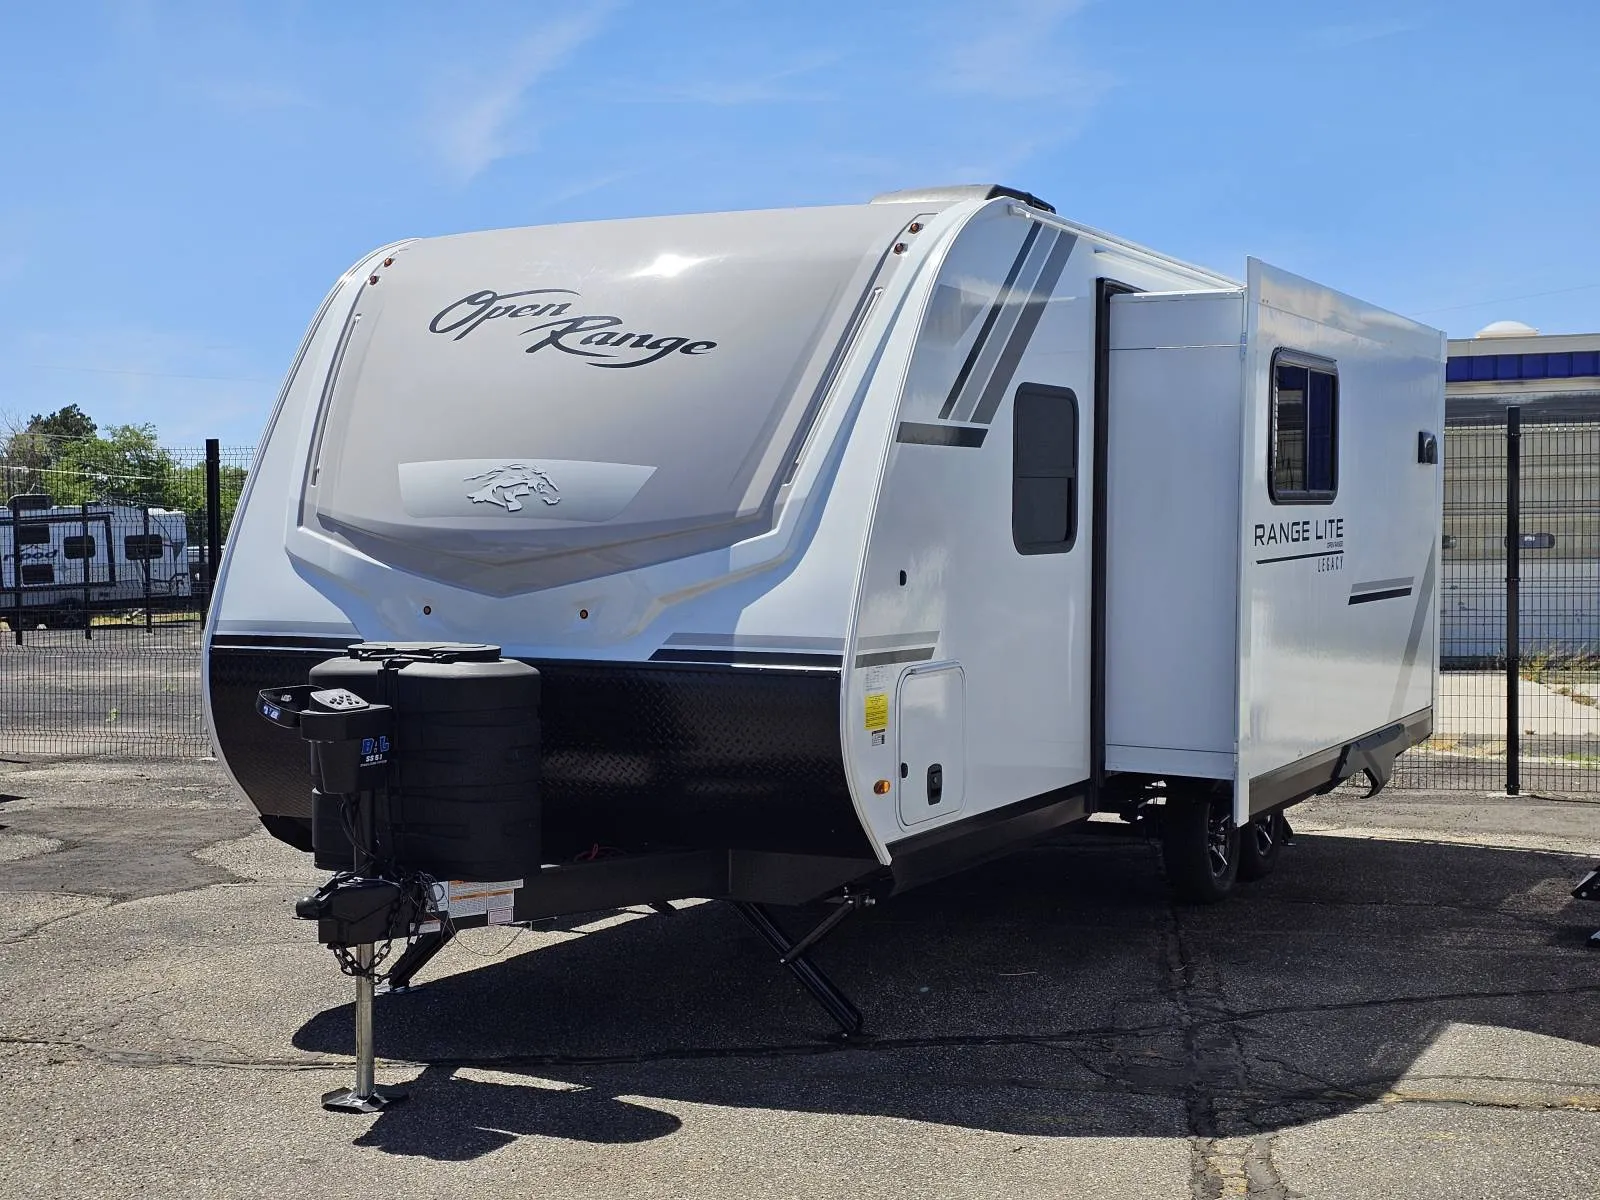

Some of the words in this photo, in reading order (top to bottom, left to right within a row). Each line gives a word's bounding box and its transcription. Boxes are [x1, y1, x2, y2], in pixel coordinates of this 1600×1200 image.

[428, 288, 581, 341] Open
[517, 315, 718, 369] Range
[1254, 520, 1310, 546] RANGE
[1315, 518, 1344, 540] LITE
[1317, 556, 1344, 573] LEGACY
